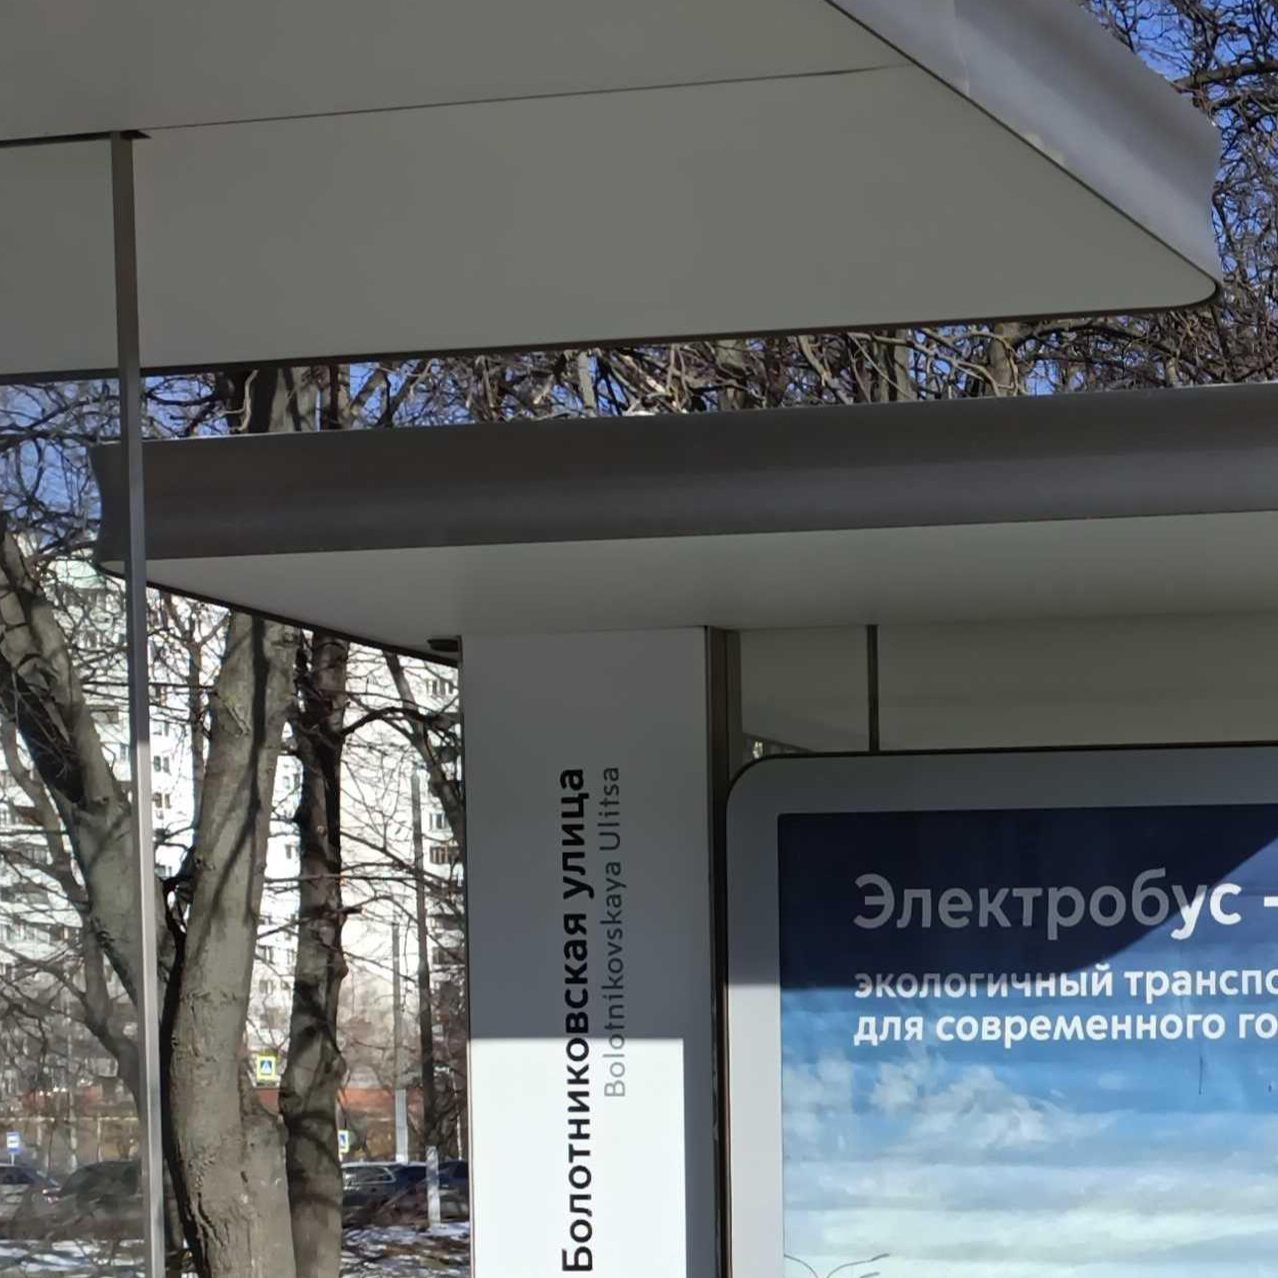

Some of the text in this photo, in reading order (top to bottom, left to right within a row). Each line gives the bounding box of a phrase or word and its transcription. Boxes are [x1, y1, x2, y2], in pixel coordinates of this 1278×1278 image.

[598, 766, 628, 1098] Bolotnikovskaya Ulitsa
[853, 868, 1243, 940] Электробус
[853, 963, 1114, 999] экологичный
[559, 767, 595, 1272] Болотниковская улица
[853, 1012, 924, 1046] для
[935, 1011, 1225, 1048] современного
